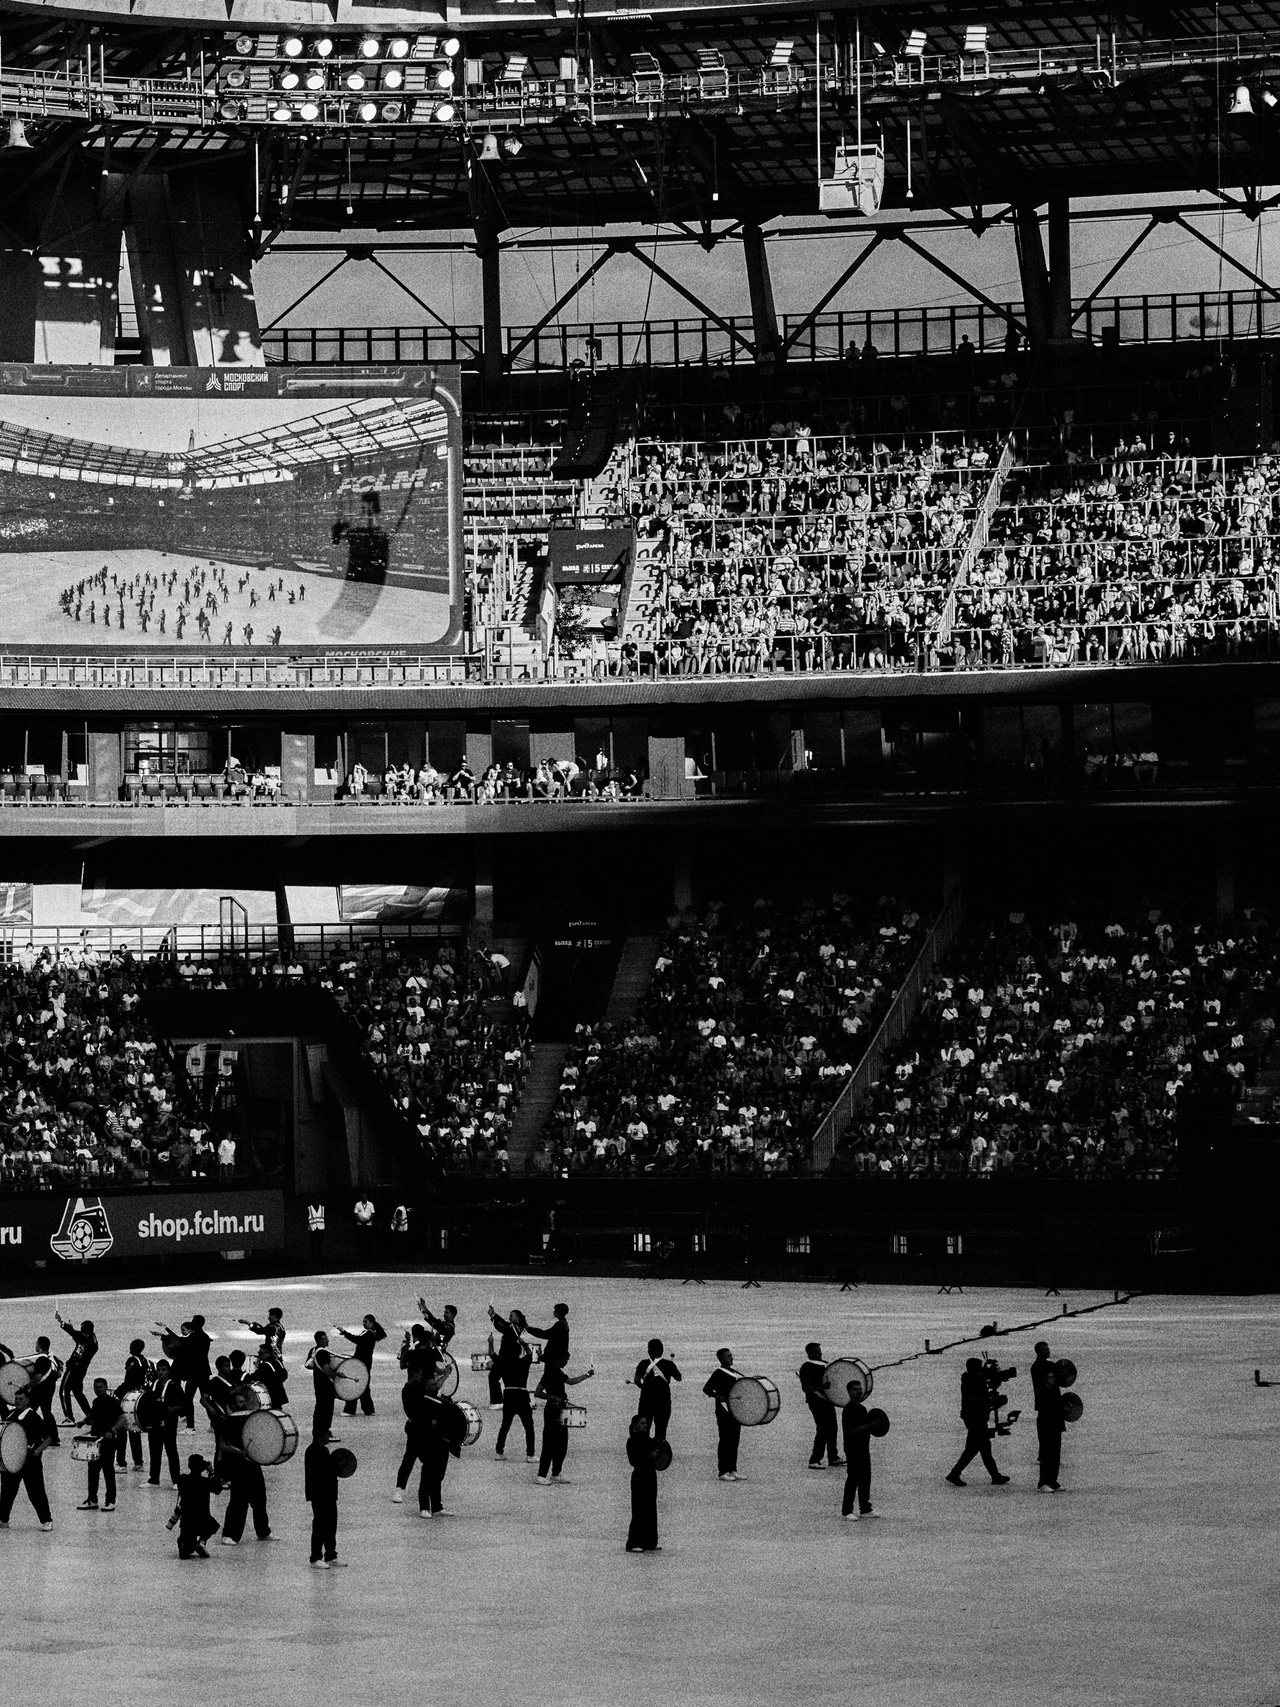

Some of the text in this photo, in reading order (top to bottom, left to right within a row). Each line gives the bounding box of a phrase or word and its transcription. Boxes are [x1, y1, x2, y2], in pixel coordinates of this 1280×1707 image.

[224, 372, 269, 382] МОСКОВСКИЙ
[224, 382, 245, 391] СПОРТ
[594, 564, 600, 573] 5
[588, 940, 593, 948] 5
[138, 1210, 265, 1241] shop.fclm.ru
